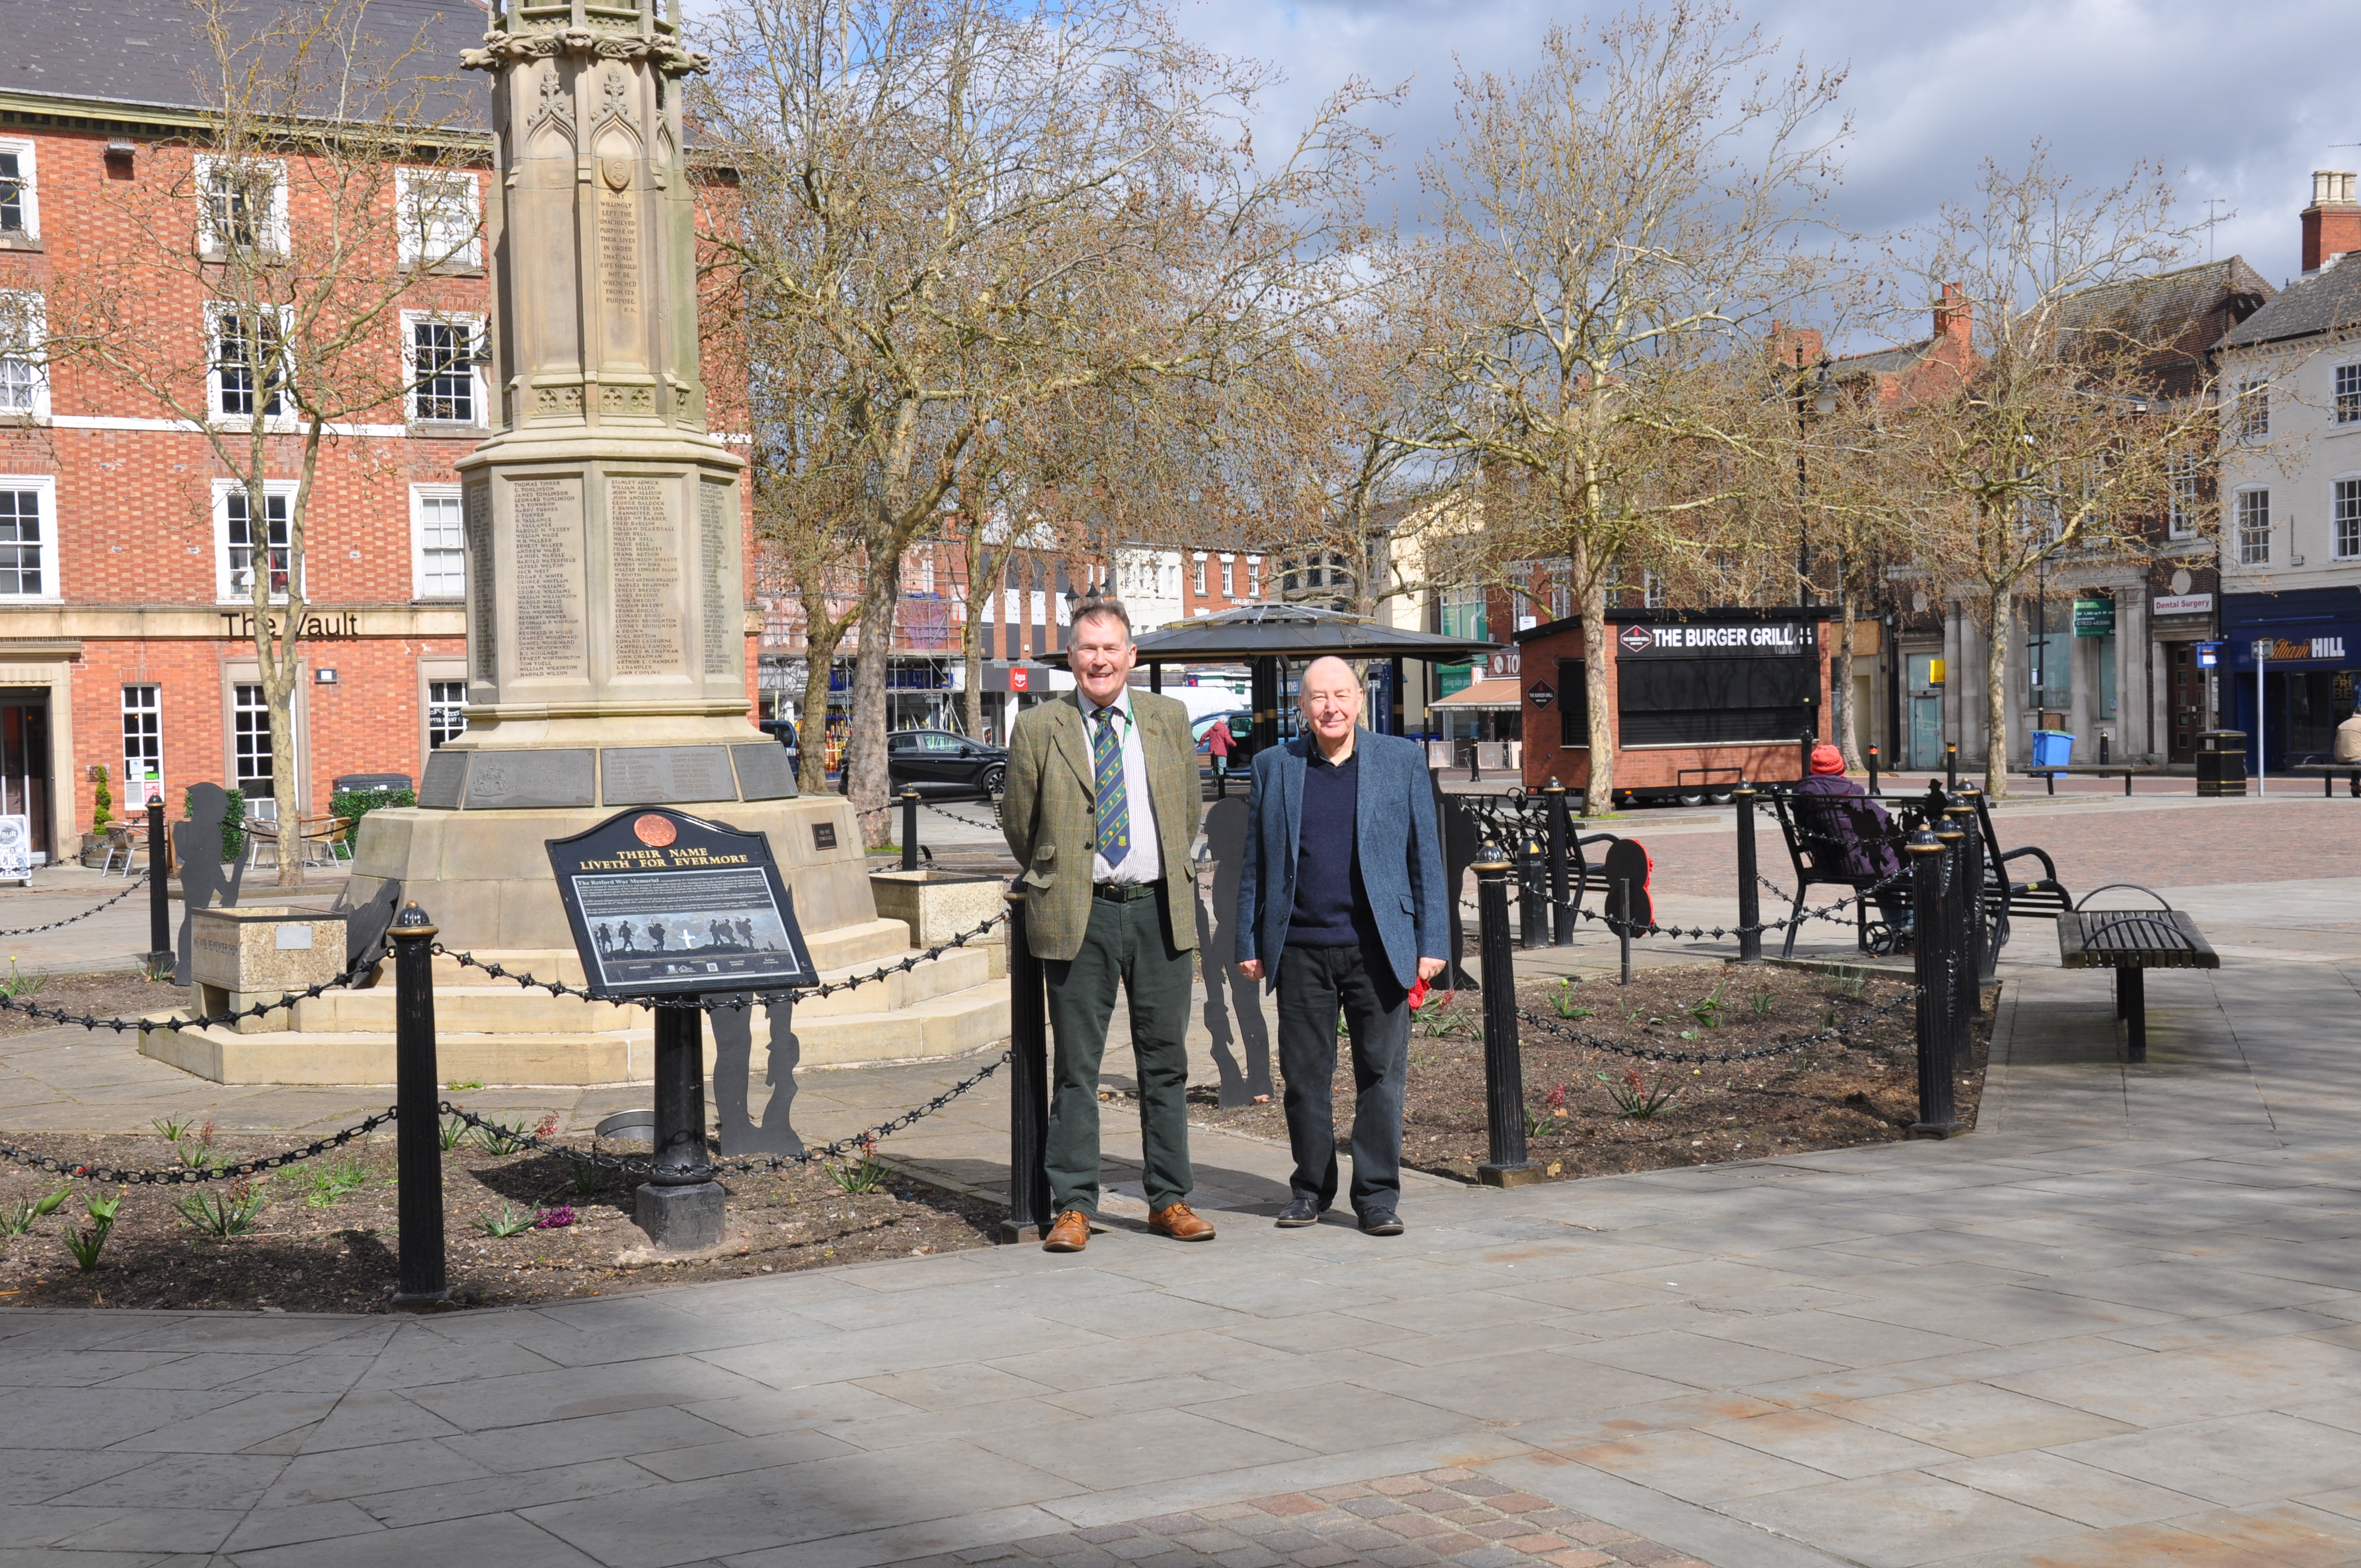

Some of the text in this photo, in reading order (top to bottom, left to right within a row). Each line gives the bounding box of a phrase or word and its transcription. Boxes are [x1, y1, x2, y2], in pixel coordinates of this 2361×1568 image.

[2156, 601, 2179, 609] Dental
[1654, 629, 1682, 647] THE
[1686, 628, 1748, 647] BURGER
[1750, 628, 1793, 646] GRILL
[2267, 636, 2346, 660] illiam HILL
[1506, 655, 1520, 673] TO
[2203, 655, 2217, 664] HILL
[1014, 672, 1025, 683] Argos
[1444, 678, 1454, 688] Giving
[439, 692, 463, 700] Vaul
[2333, 688, 2351, 699] BE
[0, 854, 18, 865] E'RE
[617, 848, 708, 860] THEIR NAME
[580, 854, 748, 870] LIVETH FOR EVERMORE
